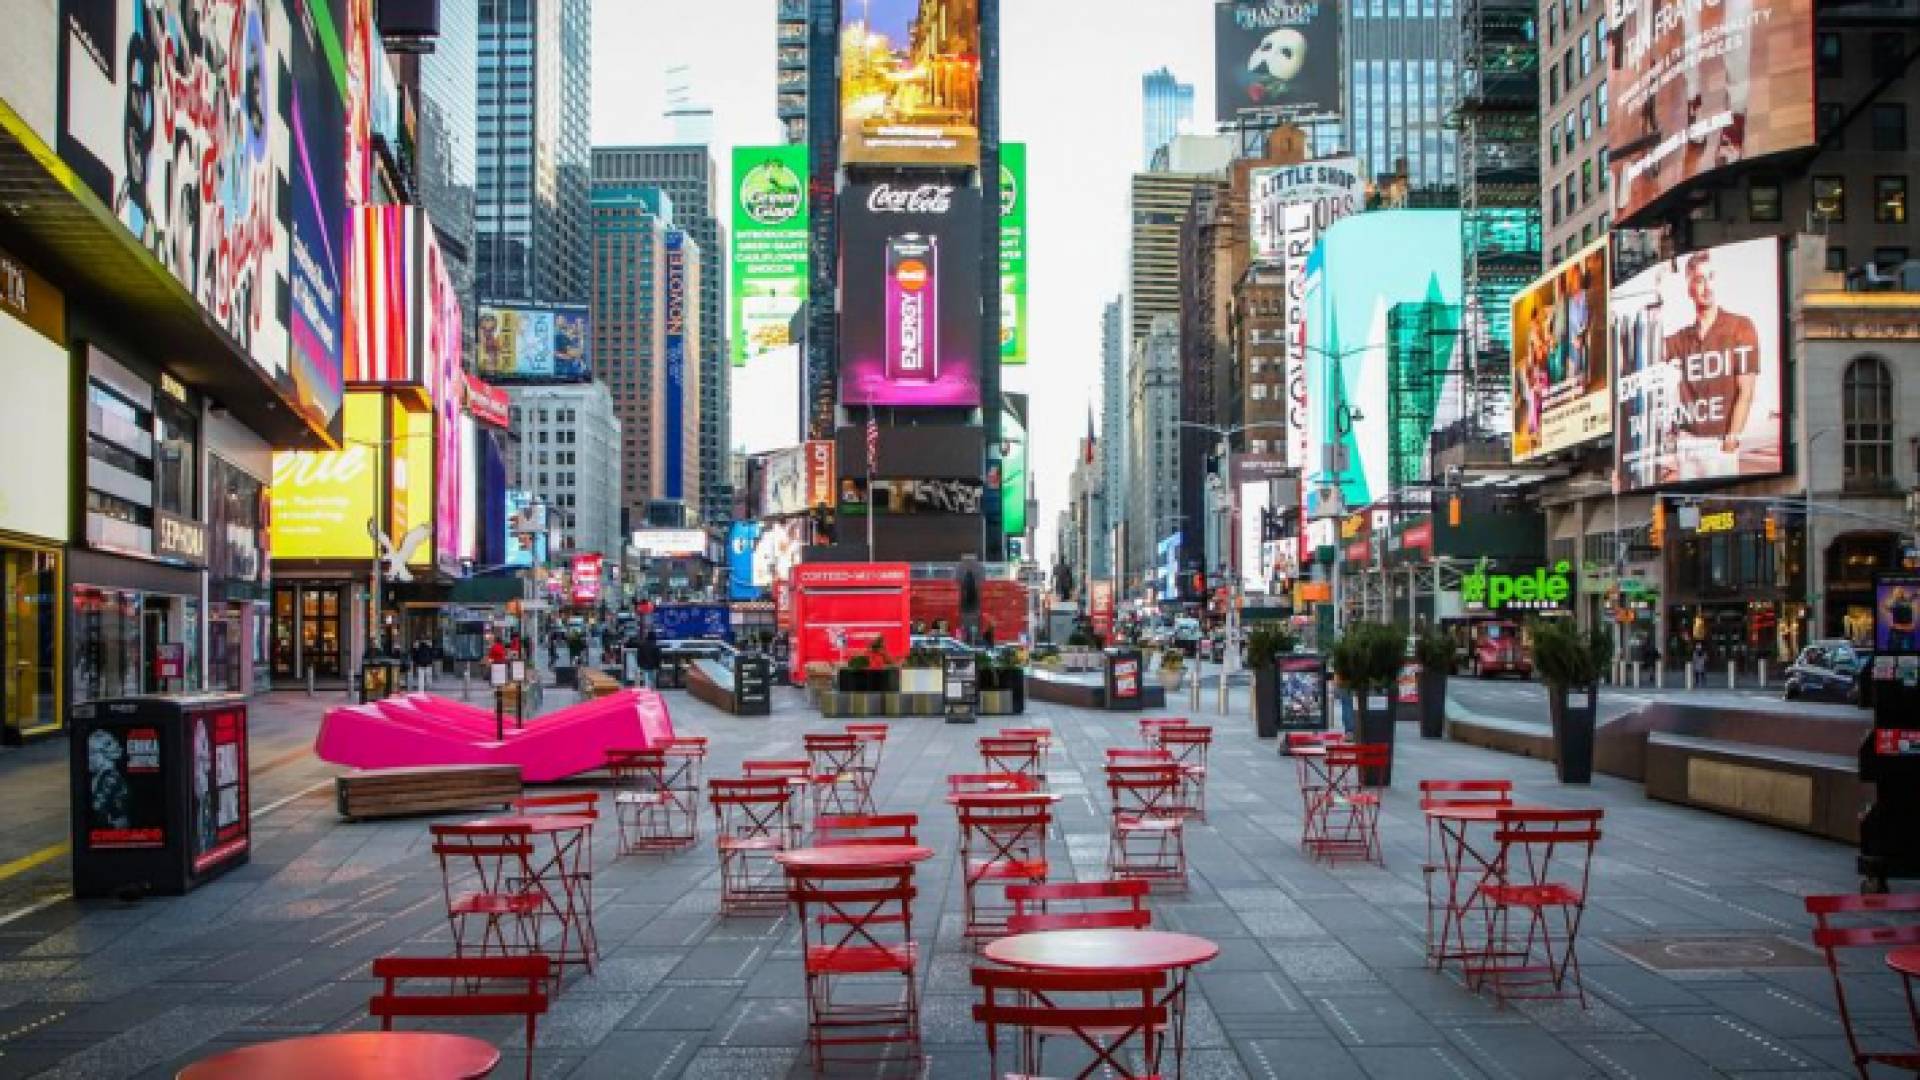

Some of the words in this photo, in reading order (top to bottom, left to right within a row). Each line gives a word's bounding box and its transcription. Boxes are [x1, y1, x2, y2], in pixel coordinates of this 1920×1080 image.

[751, 189, 801, 204] Green
[867, 183, 955, 213] Coca-Cola
[1261, 164, 1314, 197] LITTLE
[1317, 166, 1356, 189] SHOP
[1261, 194, 1355, 249] HOORS
[667, 250, 684, 334] NOVOTEL
[901, 291, 921, 369] ENERGY
[1288, 215, 1311, 429] COVERGIRL
[1687, 345, 1754, 382] EDIT
